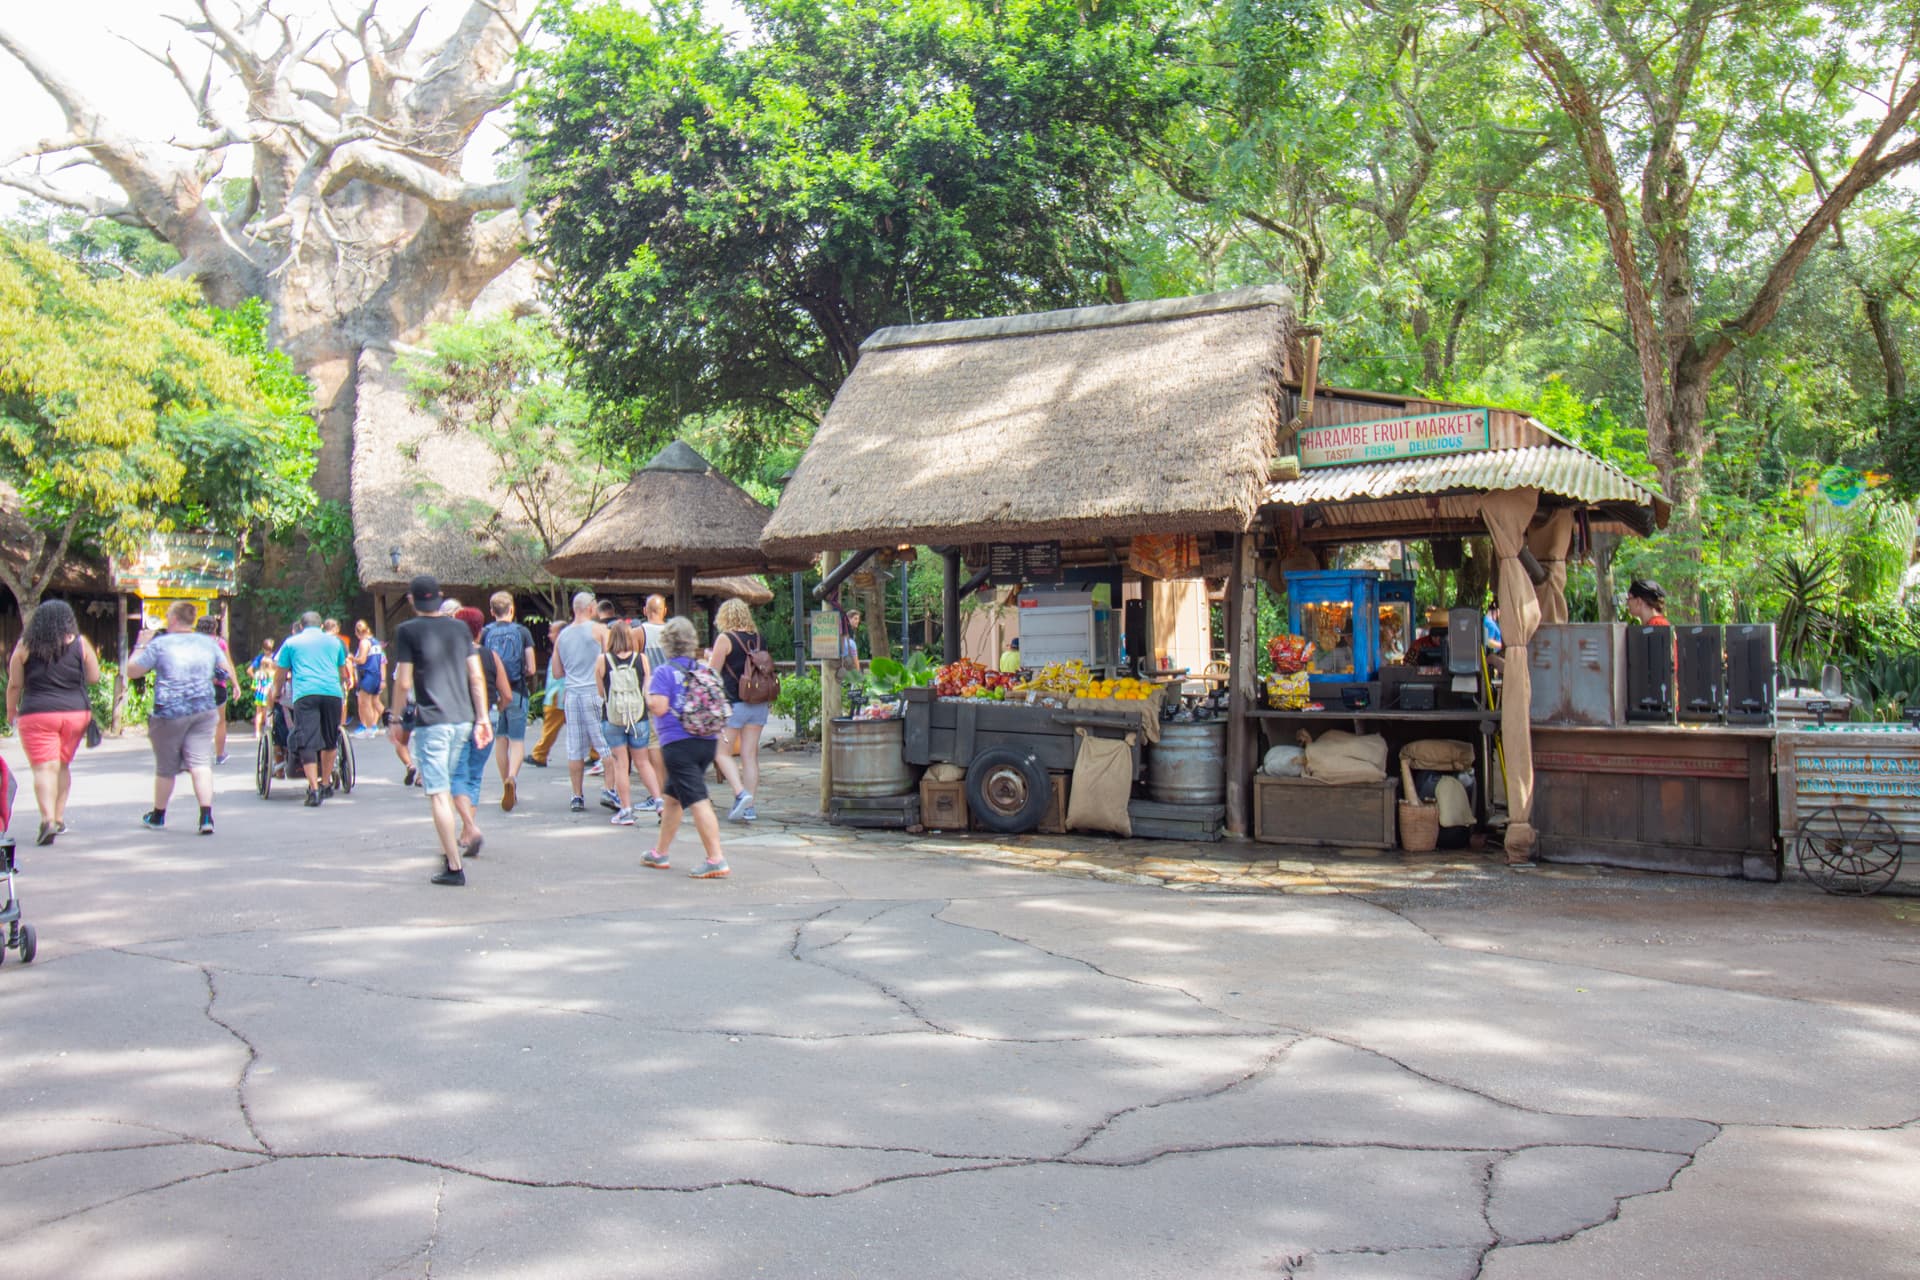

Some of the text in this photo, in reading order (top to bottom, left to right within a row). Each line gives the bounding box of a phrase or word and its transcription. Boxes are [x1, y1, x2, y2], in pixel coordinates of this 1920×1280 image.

[1305, 413, 1473, 450] HARAMBE FRUIT MARKET
[1325, 436, 1463, 462] TASTY FRESH DELICIOUS
[1796, 757, 1865, 774] BARIDI
